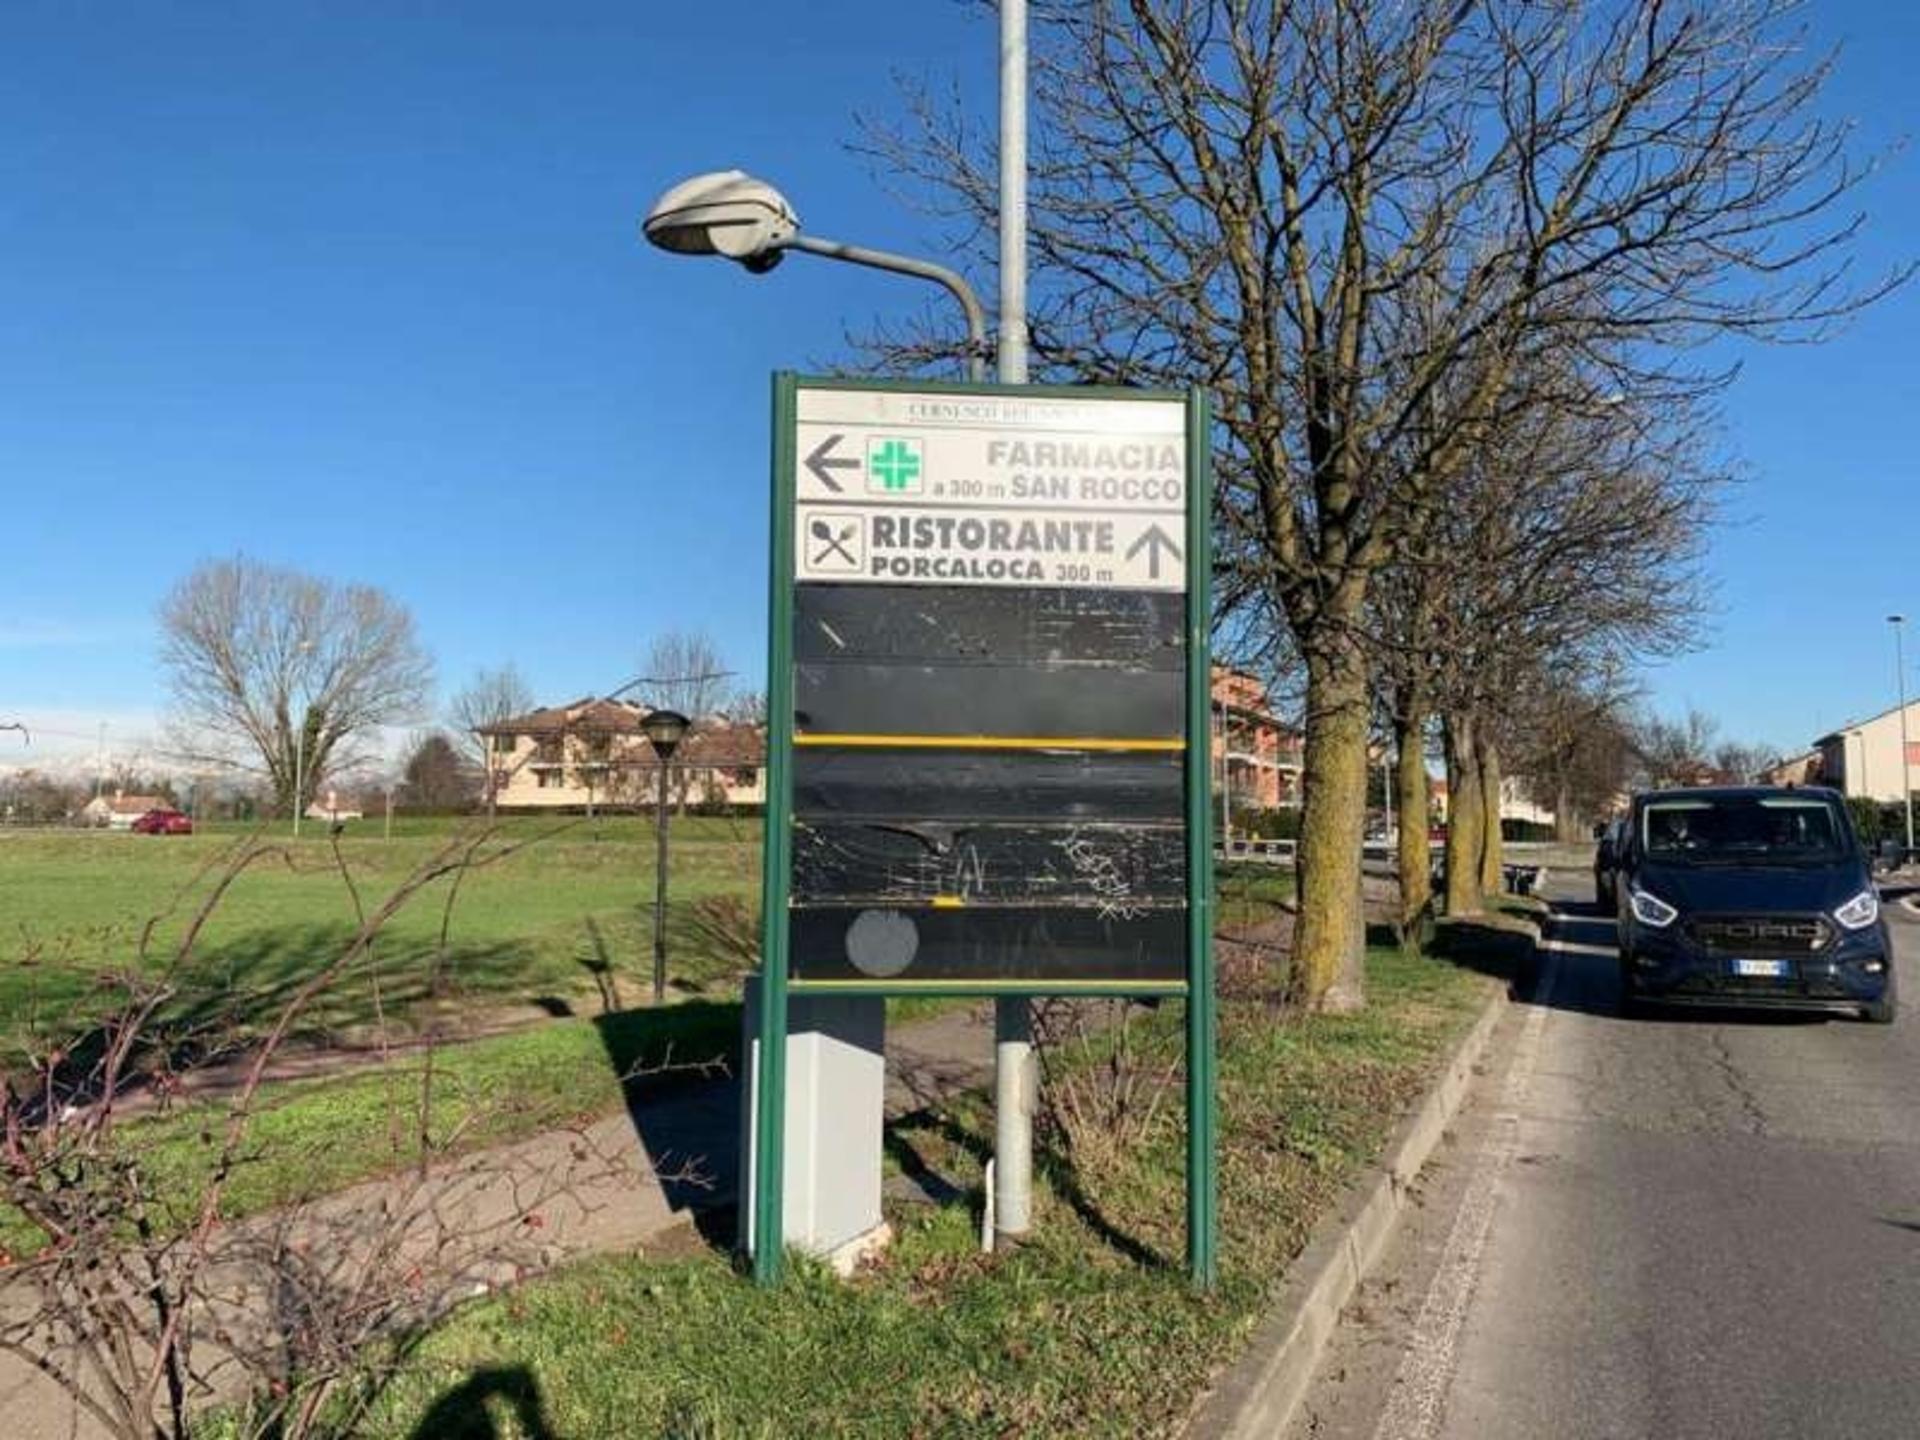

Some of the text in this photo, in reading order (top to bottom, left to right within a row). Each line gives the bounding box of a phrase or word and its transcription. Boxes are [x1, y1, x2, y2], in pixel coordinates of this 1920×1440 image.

[987, 441, 1181, 470] FARMACIA
[934, 476, 1181, 501] a 300 m SAN ROCCO
[872, 516, 1114, 552] RISTORANTE
[872, 556, 1114, 581] PORCALOCA 300 m
